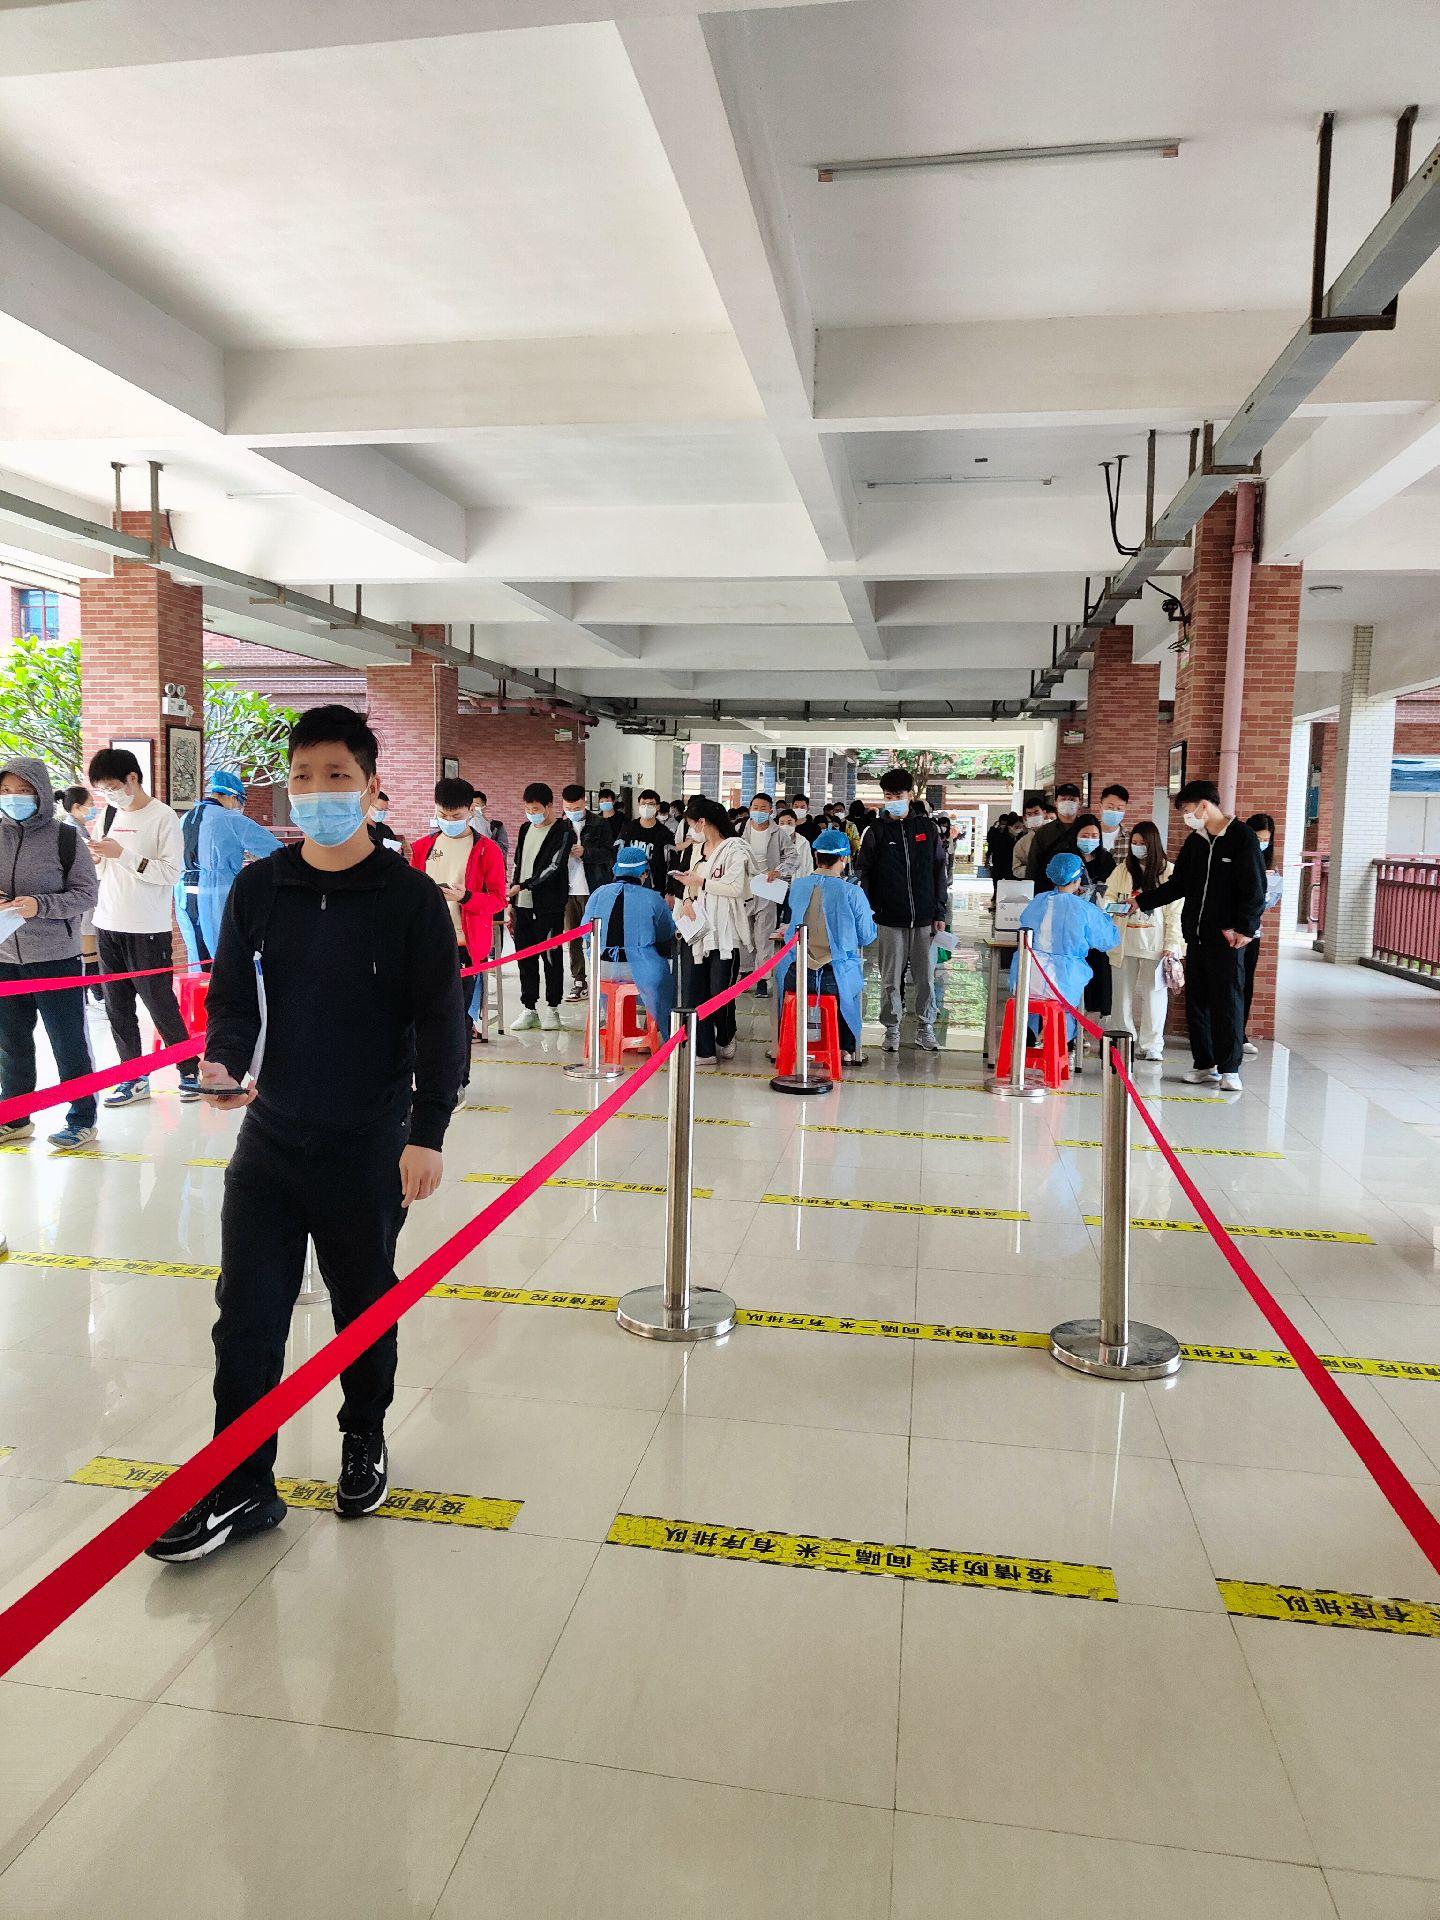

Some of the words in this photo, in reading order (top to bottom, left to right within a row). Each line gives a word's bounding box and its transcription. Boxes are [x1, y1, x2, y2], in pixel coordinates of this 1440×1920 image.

[746, 1312, 826, 1328] 有序排队
[838, 1321, 920, 1336] 间隔一米
[932, 1327, 1018, 1343] 疫情防控
[1270, 1354, 1364, 1371] 间隔米
[381, 1495, 466, 1516] 疫情防
[663, 1526, 776, 1556] 有序排队
[793, 1541, 912, 1570] 间隔一米
[930, 1556, 1054, 1585] 疫情防控
[1276, 1593, 1414, 1625] 有序排队
